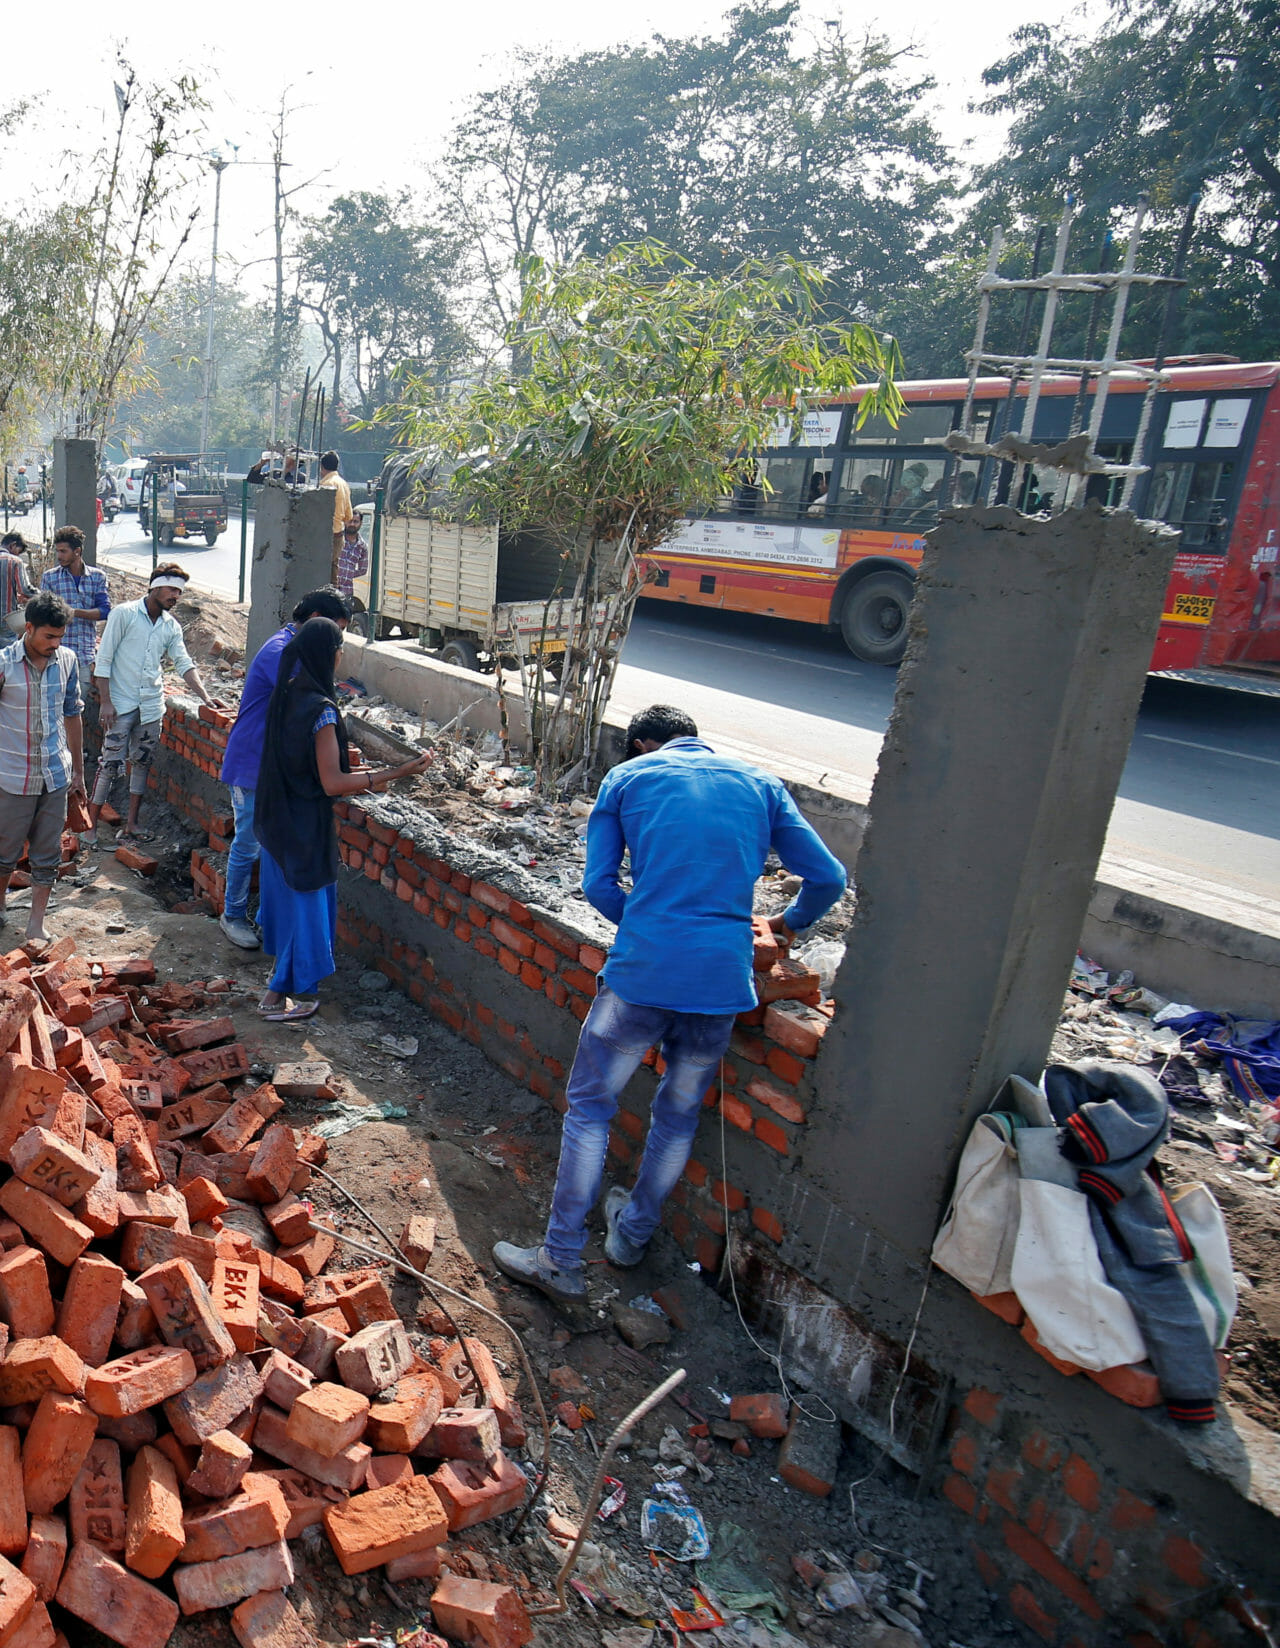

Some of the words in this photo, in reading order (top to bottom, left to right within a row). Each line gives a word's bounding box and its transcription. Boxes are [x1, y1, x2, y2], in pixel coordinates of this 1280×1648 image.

[1175, 604, 1210, 617] 7422
[209, 1053, 241, 1072] BK
[32, 1157, 70, 1186] BK
[224, 1266, 248, 1300] BK
[84, 1482, 114, 1543] BK
